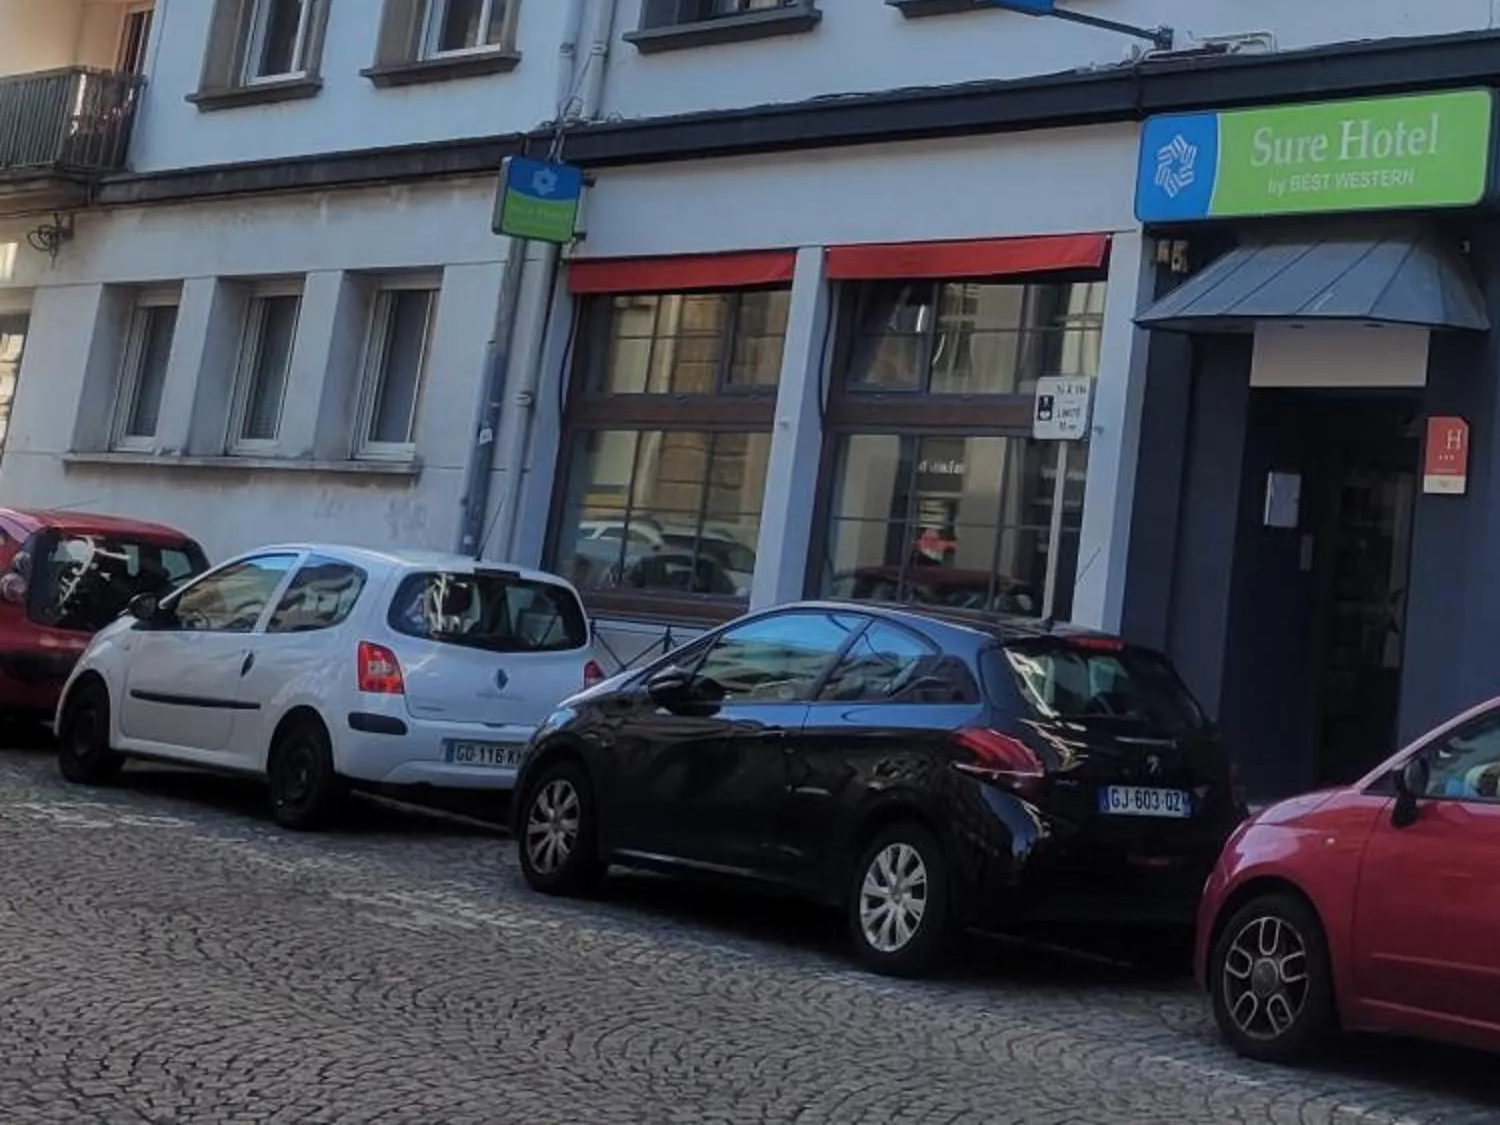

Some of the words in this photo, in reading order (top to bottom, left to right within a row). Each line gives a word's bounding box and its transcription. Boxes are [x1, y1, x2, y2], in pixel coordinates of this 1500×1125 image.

[1250, 125, 1329, 167] Sure
[1338, 112, 1440, 161] Hotel
[1268, 177, 1287, 198] by
[1289, 175, 1330, 192] BEST
[1334, 168, 1416, 189] WESTERN
